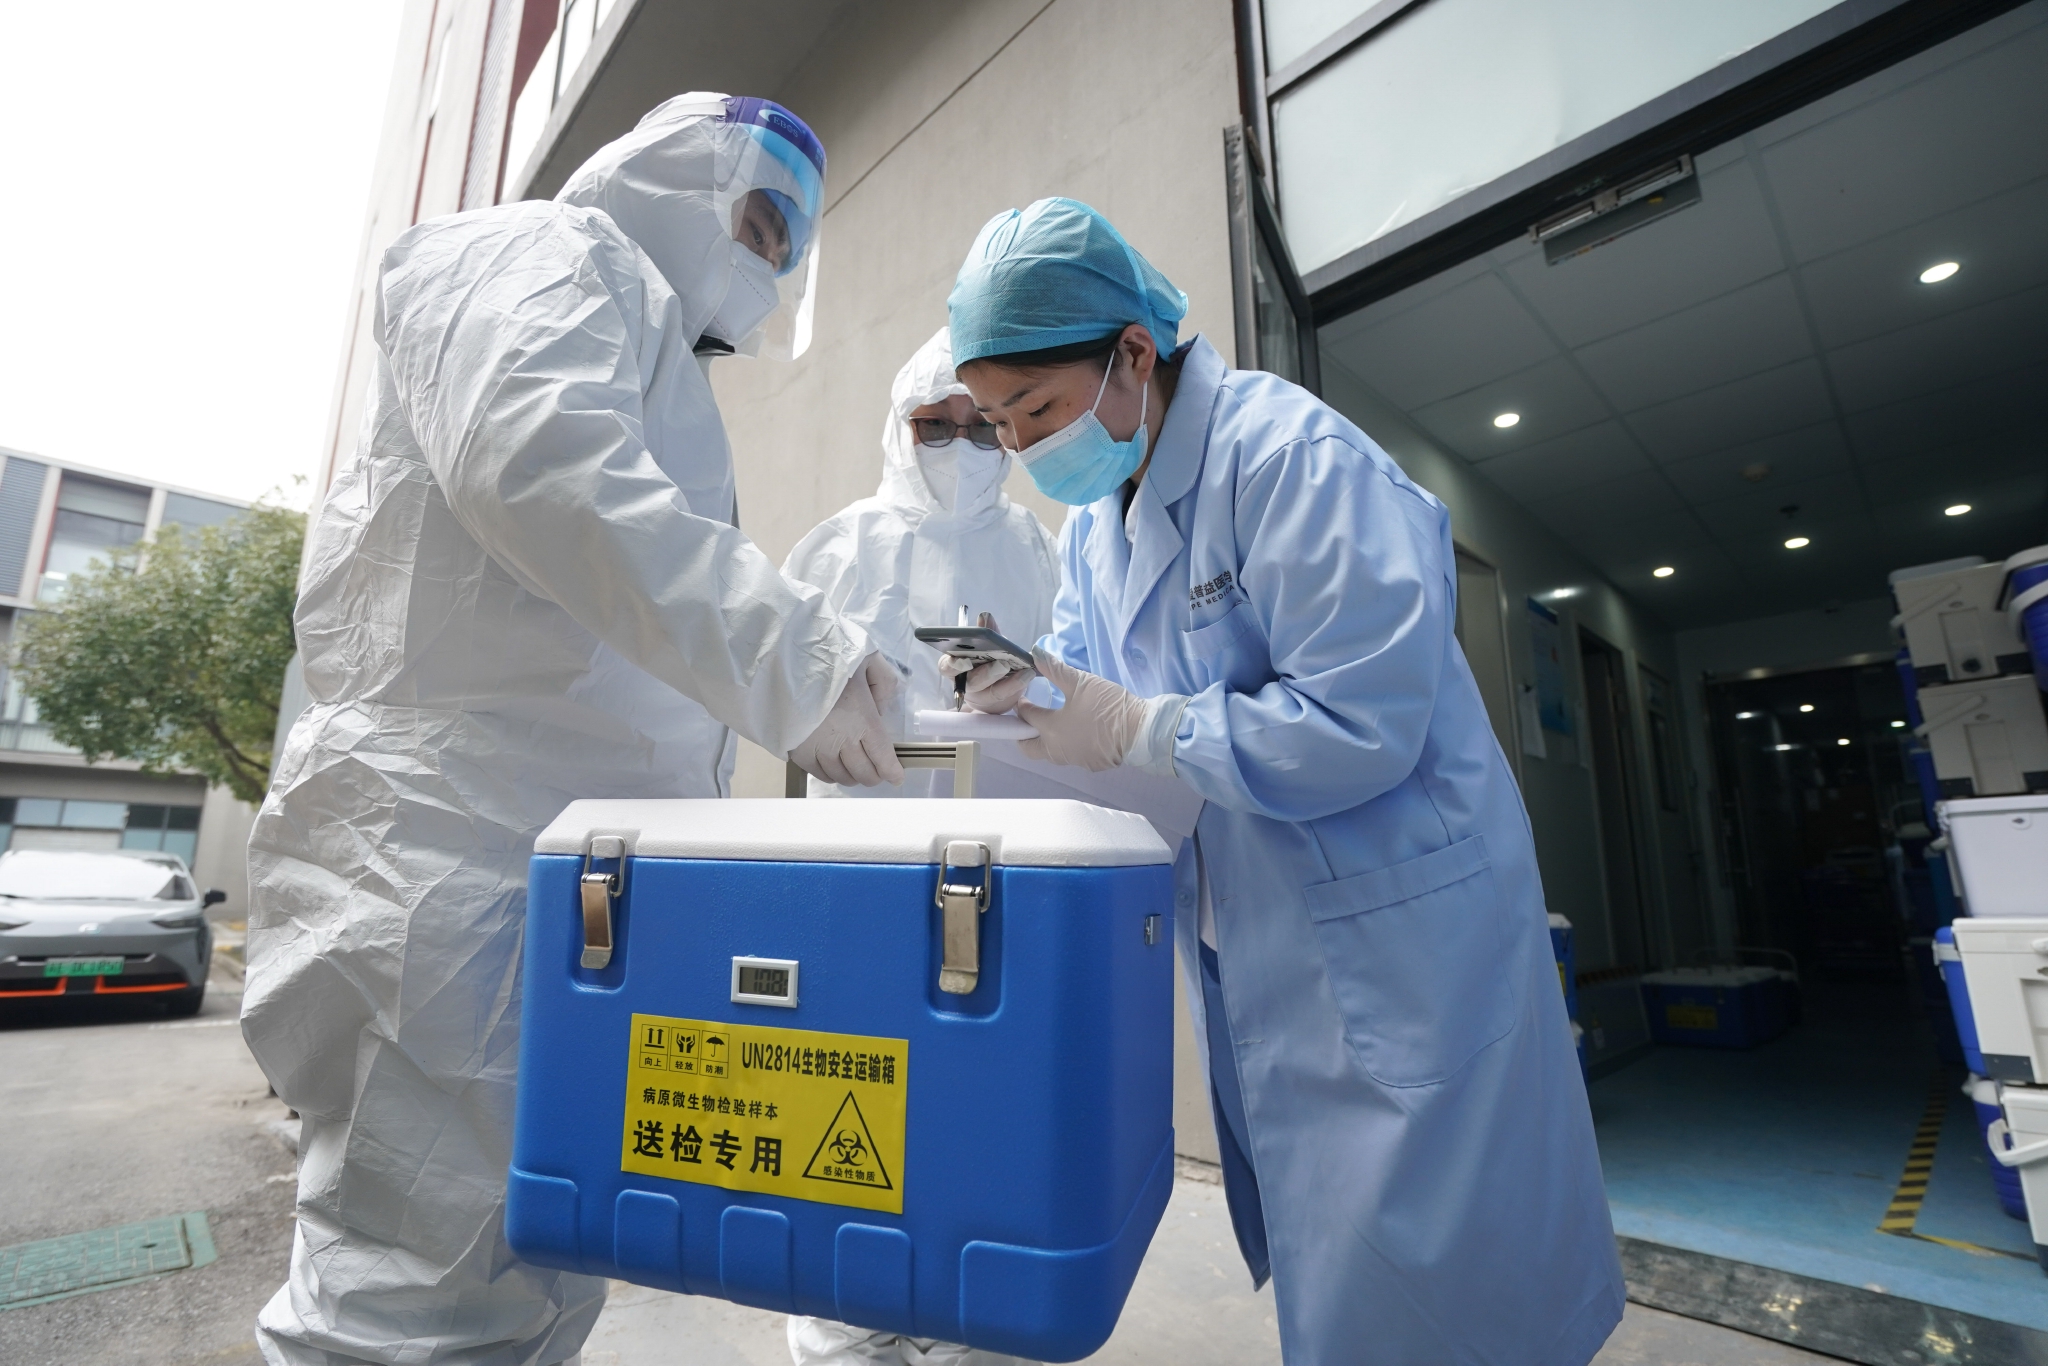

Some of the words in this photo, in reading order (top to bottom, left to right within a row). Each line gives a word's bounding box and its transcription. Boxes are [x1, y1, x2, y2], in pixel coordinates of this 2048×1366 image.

[644, 1056, 662, 1068] 向上
[674, 1060, 694, 1071] 轻放
[705, 1064, 724, 1076] 防潮
[742, 1042, 896, 1085] UN2814生物安全运输箱
[643, 1086, 779, 1121] 病原微生物检验样本
[632, 1119, 782, 1177] 送检专用
[823, 1165, 876, 1182] 感染性物质
